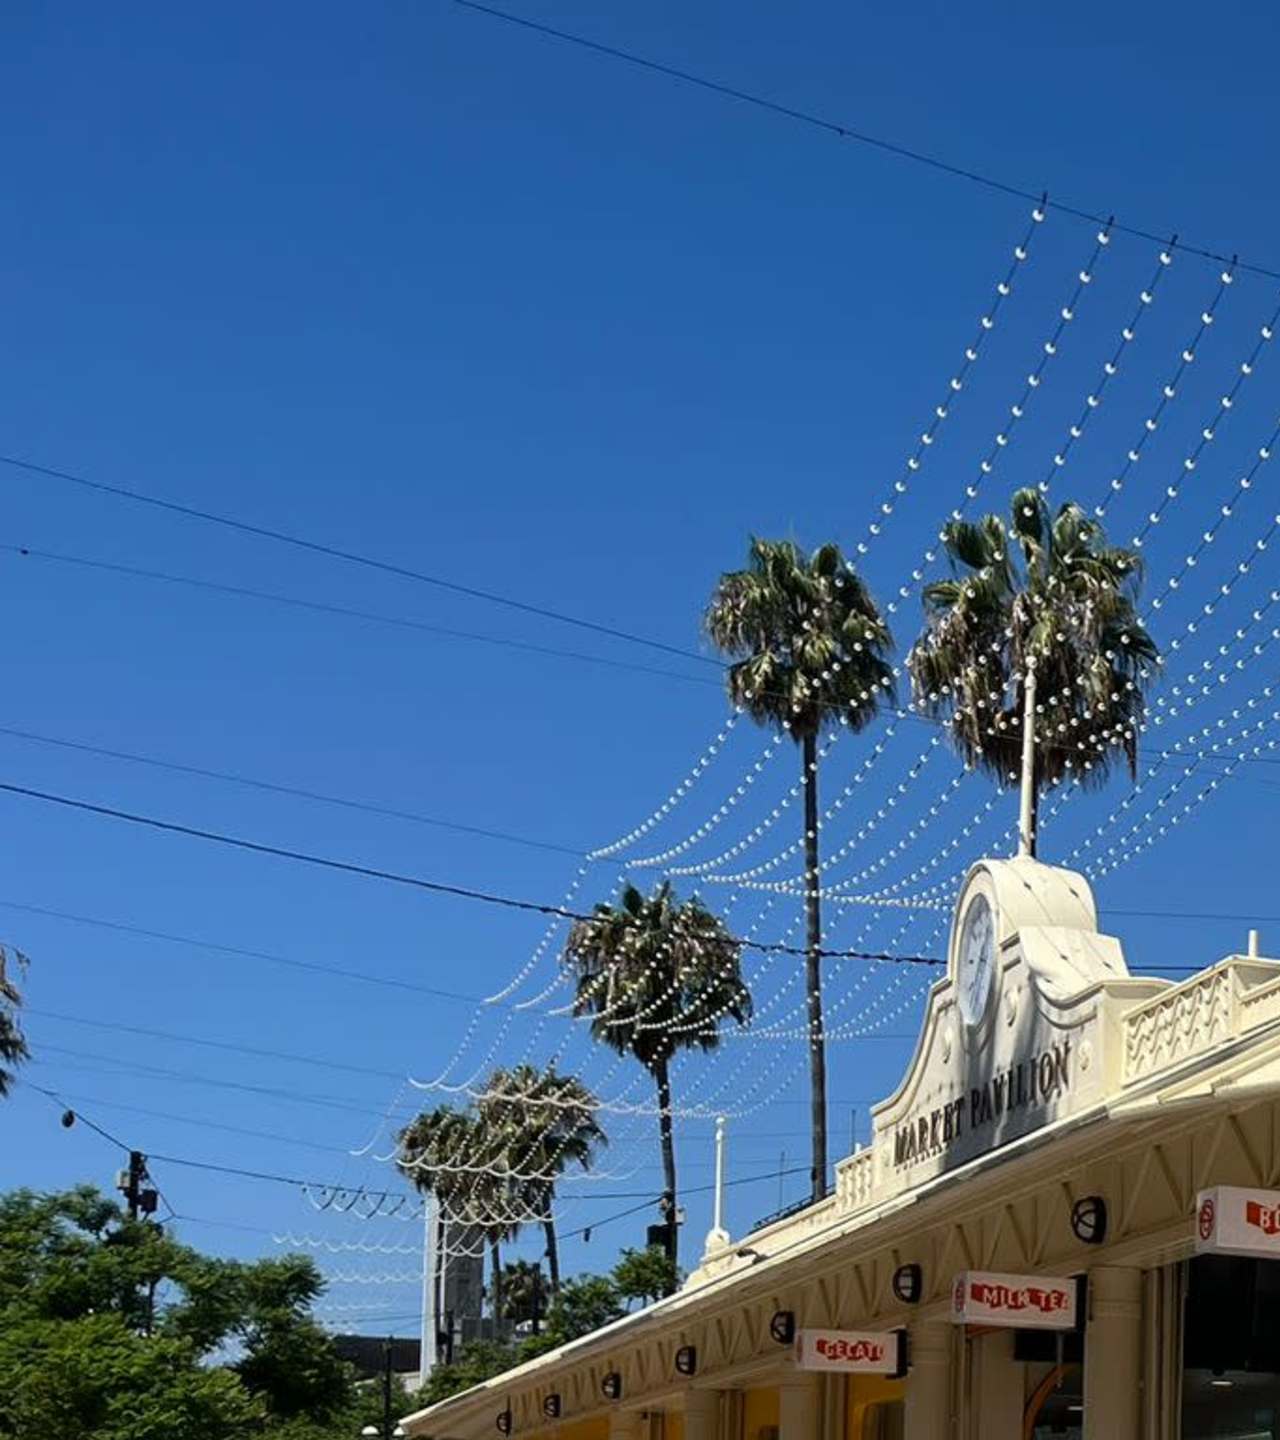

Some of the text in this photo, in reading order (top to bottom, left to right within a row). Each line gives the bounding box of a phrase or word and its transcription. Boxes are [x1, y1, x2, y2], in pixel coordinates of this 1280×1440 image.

[893, 1039, 1072, 1167] MARKET PAVILION
[982, 1287, 1031, 1307] MILK
